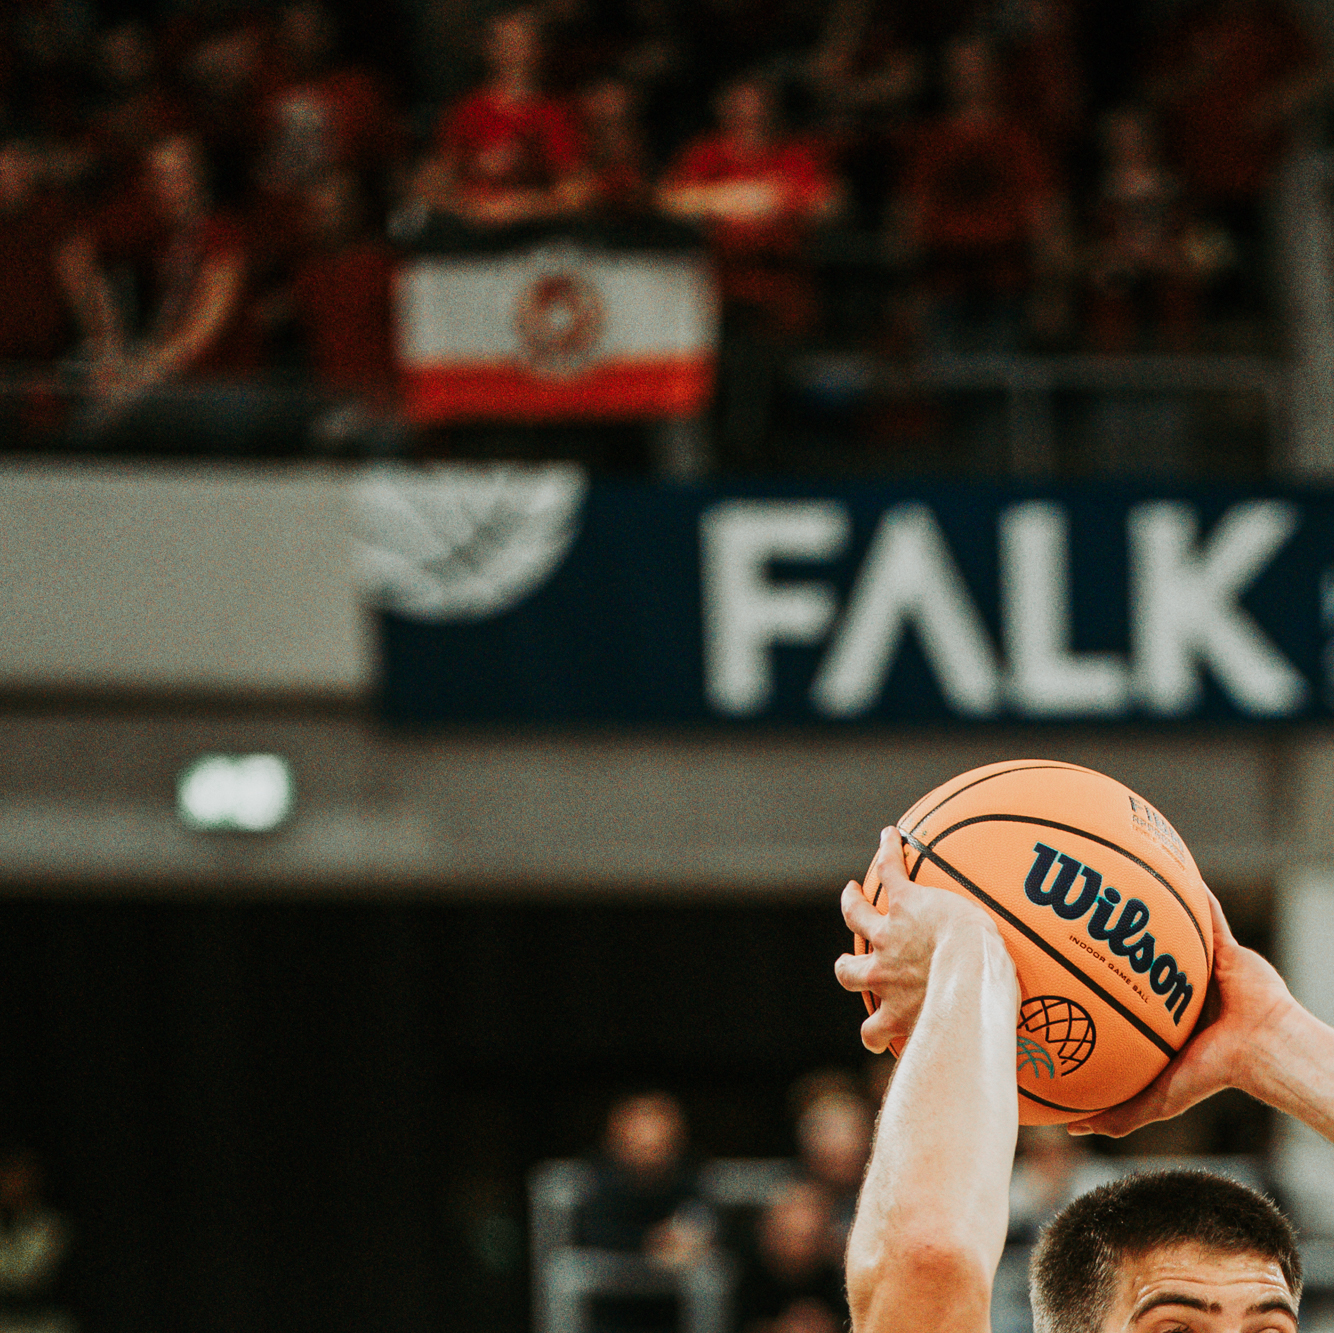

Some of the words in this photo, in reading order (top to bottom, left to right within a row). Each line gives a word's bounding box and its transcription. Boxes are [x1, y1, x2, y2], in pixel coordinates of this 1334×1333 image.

[701, 499, 1306, 714] FALK
[1024, 841, 1193, 1026] Wilson
[1069, 935, 1106, 963] INDOOR
[1107, 963, 1132, 985] GAME
[1132, 985, 1149, 1004] BALL
